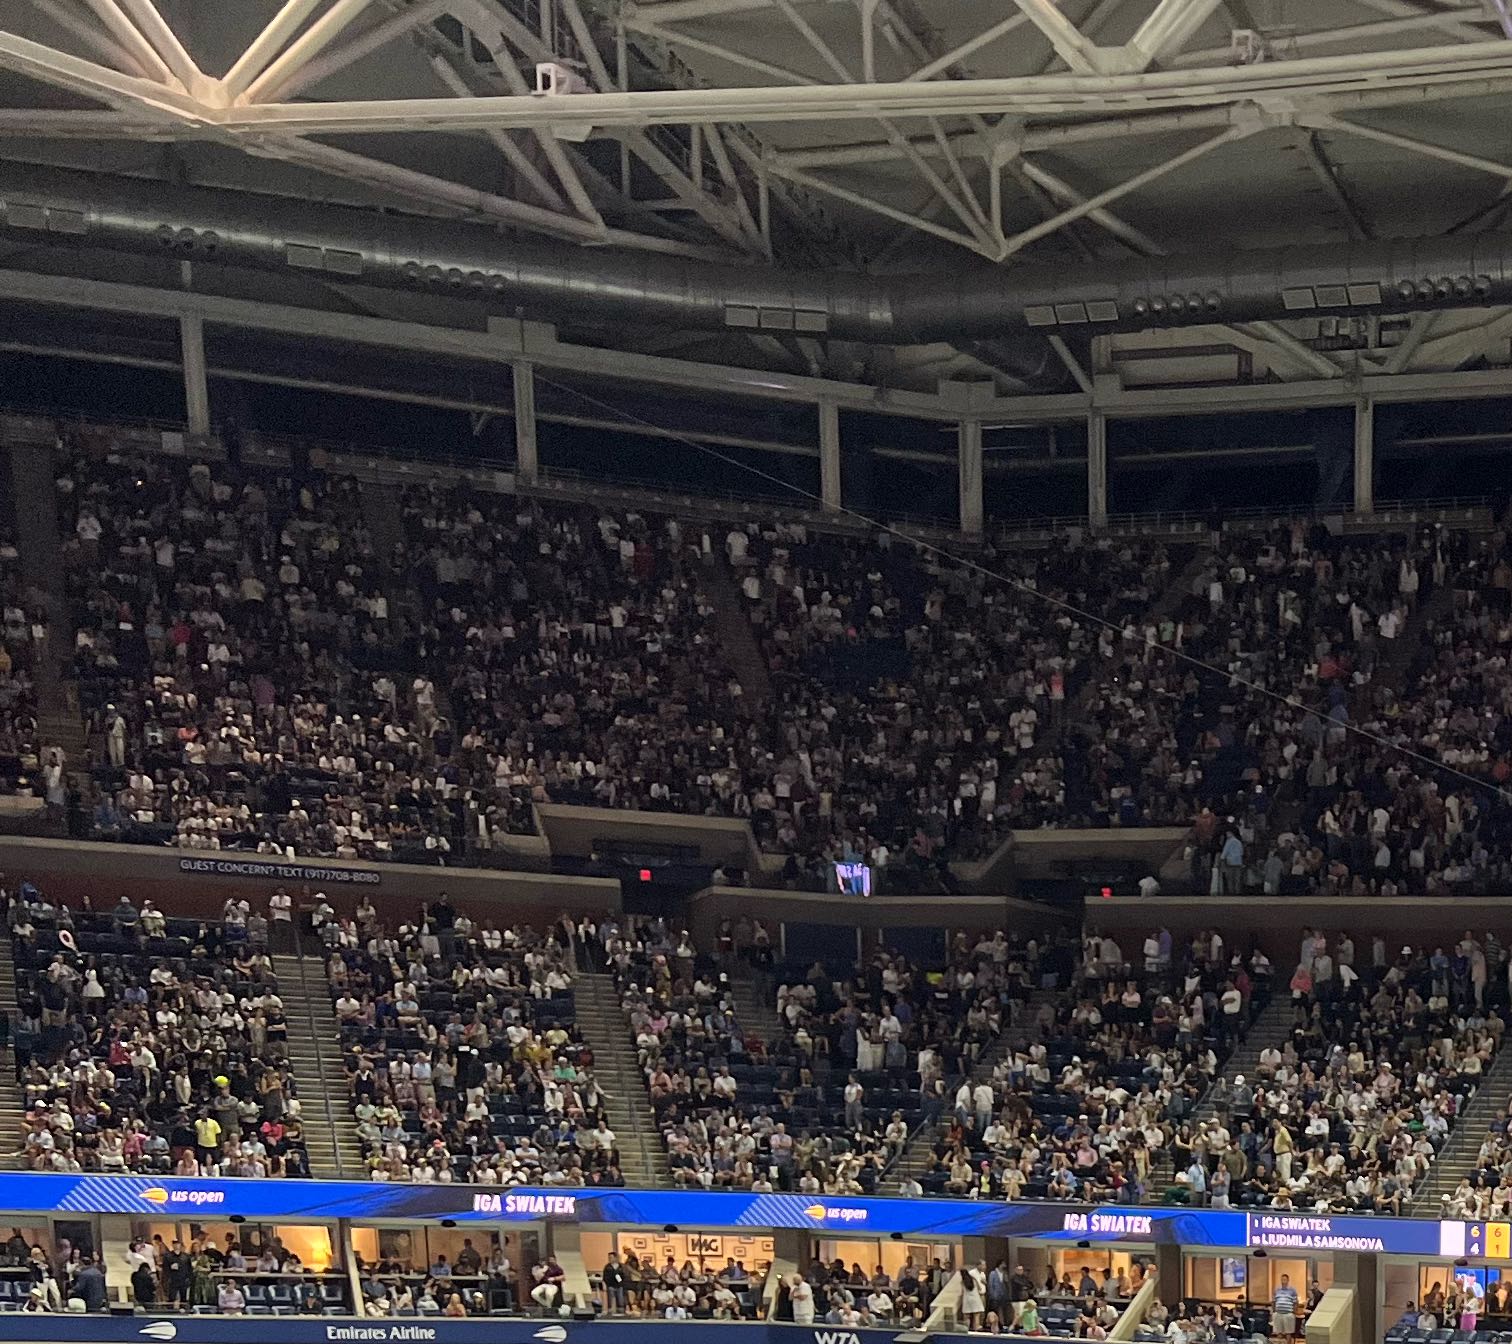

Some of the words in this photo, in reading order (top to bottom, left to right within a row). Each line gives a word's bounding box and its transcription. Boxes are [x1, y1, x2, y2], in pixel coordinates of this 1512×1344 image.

[180, 859, 215, 871] GUEST
[218, 862, 275, 876] CONCERN?
[276, 866, 302, 878] TEXT
[171, 1190, 188, 1202] us
[188, 1190, 224, 1205] open
[473, 1194, 502, 1212] IGA
[505, 1195, 576, 1214] SWIATEK
[827, 1207, 840, 1218] us
[840, 1208, 867, 1221] open
[1064, 1213, 1088, 1231] IGA
[1090, 1214, 1152, 1233] SWIATEK
[1262, 1216, 1280, 1229] IGA
[1280, 1217, 1331, 1231] SWIATEK
[1471, 1225, 1480, 1238] 6
[1495, 1227, 1502, 1238] 6
[1262, 1233, 1313, 1248] LIUDMILA
[1313, 1235, 1384, 1251] SAMSONOVA
[1470, 1242, 1480, 1255] 4
[326, 1325, 387, 1340] Emirates
[389, 1326, 436, 1340] Airline
